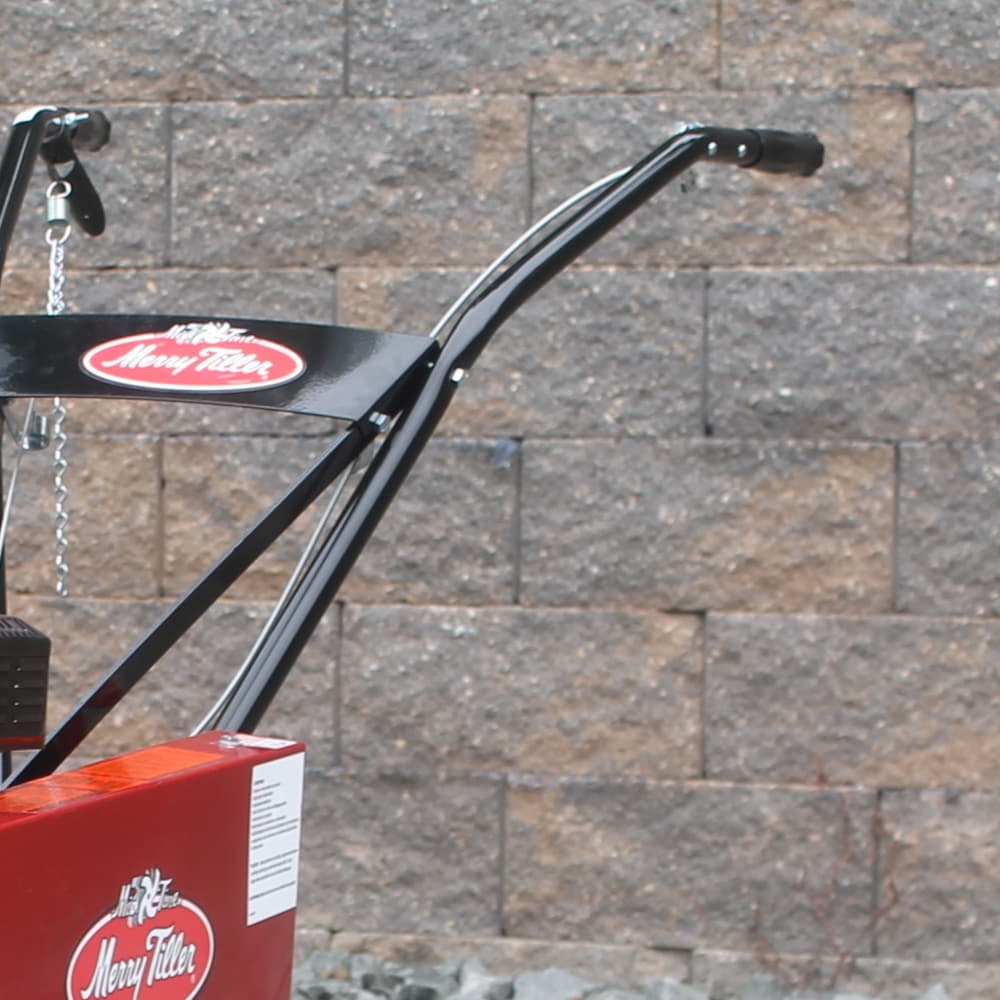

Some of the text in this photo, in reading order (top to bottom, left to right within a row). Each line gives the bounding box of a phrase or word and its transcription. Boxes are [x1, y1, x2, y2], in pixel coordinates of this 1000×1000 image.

[101, 343, 273, 377] Merry Tiller
[145, 926, 197, 986] Tiller
